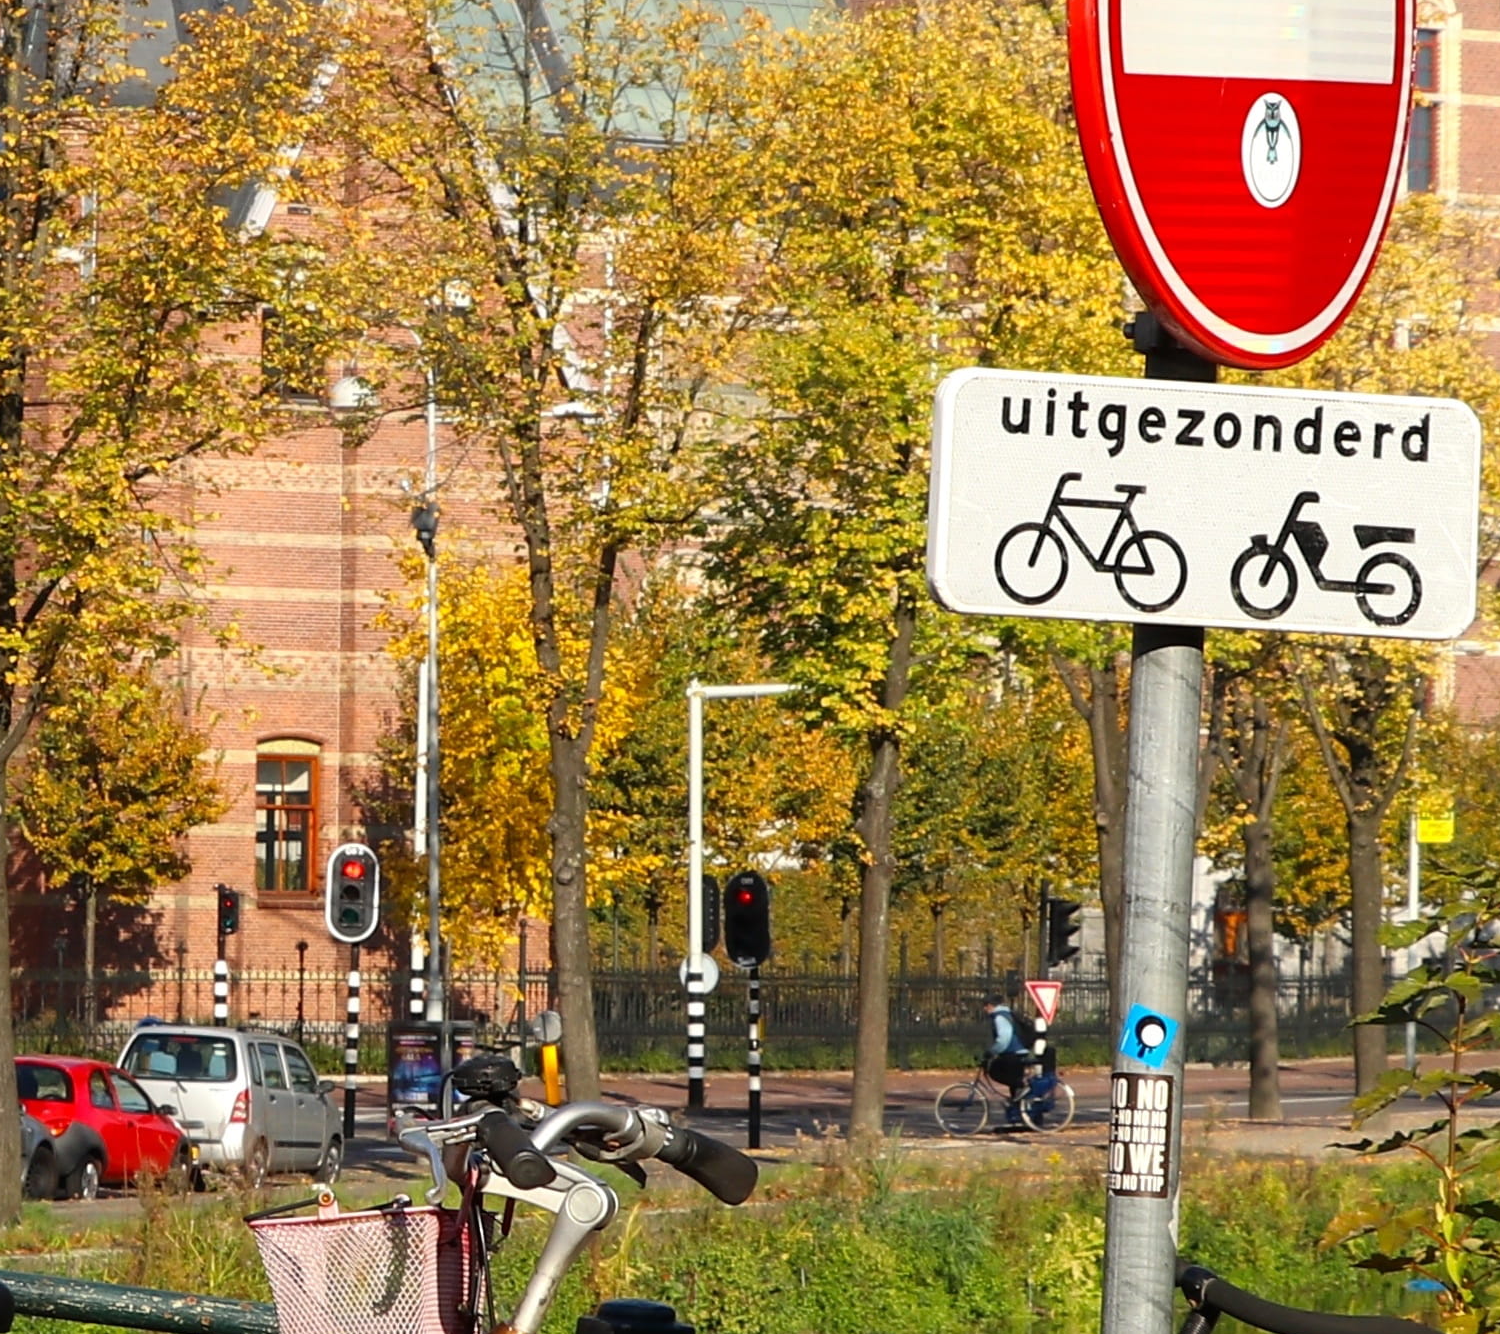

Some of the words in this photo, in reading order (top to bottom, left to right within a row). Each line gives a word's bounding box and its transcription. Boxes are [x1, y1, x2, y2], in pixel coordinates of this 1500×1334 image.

[1001, 387, 1431, 464] uitgezonderd
[1137, 1079, 1169, 1110] NO
[1133, 1110, 1149, 1126] NO
[1151, 1111, 1167, 1127] NO
[1132, 1127, 1148, 1143] NO
[1151, 1128, 1166, 1144] NO
[1129, 1143, 1165, 1175] WE
[1122, 1174, 1138, 1190] NO
[1139, 1175, 1165, 1192] TTIP
